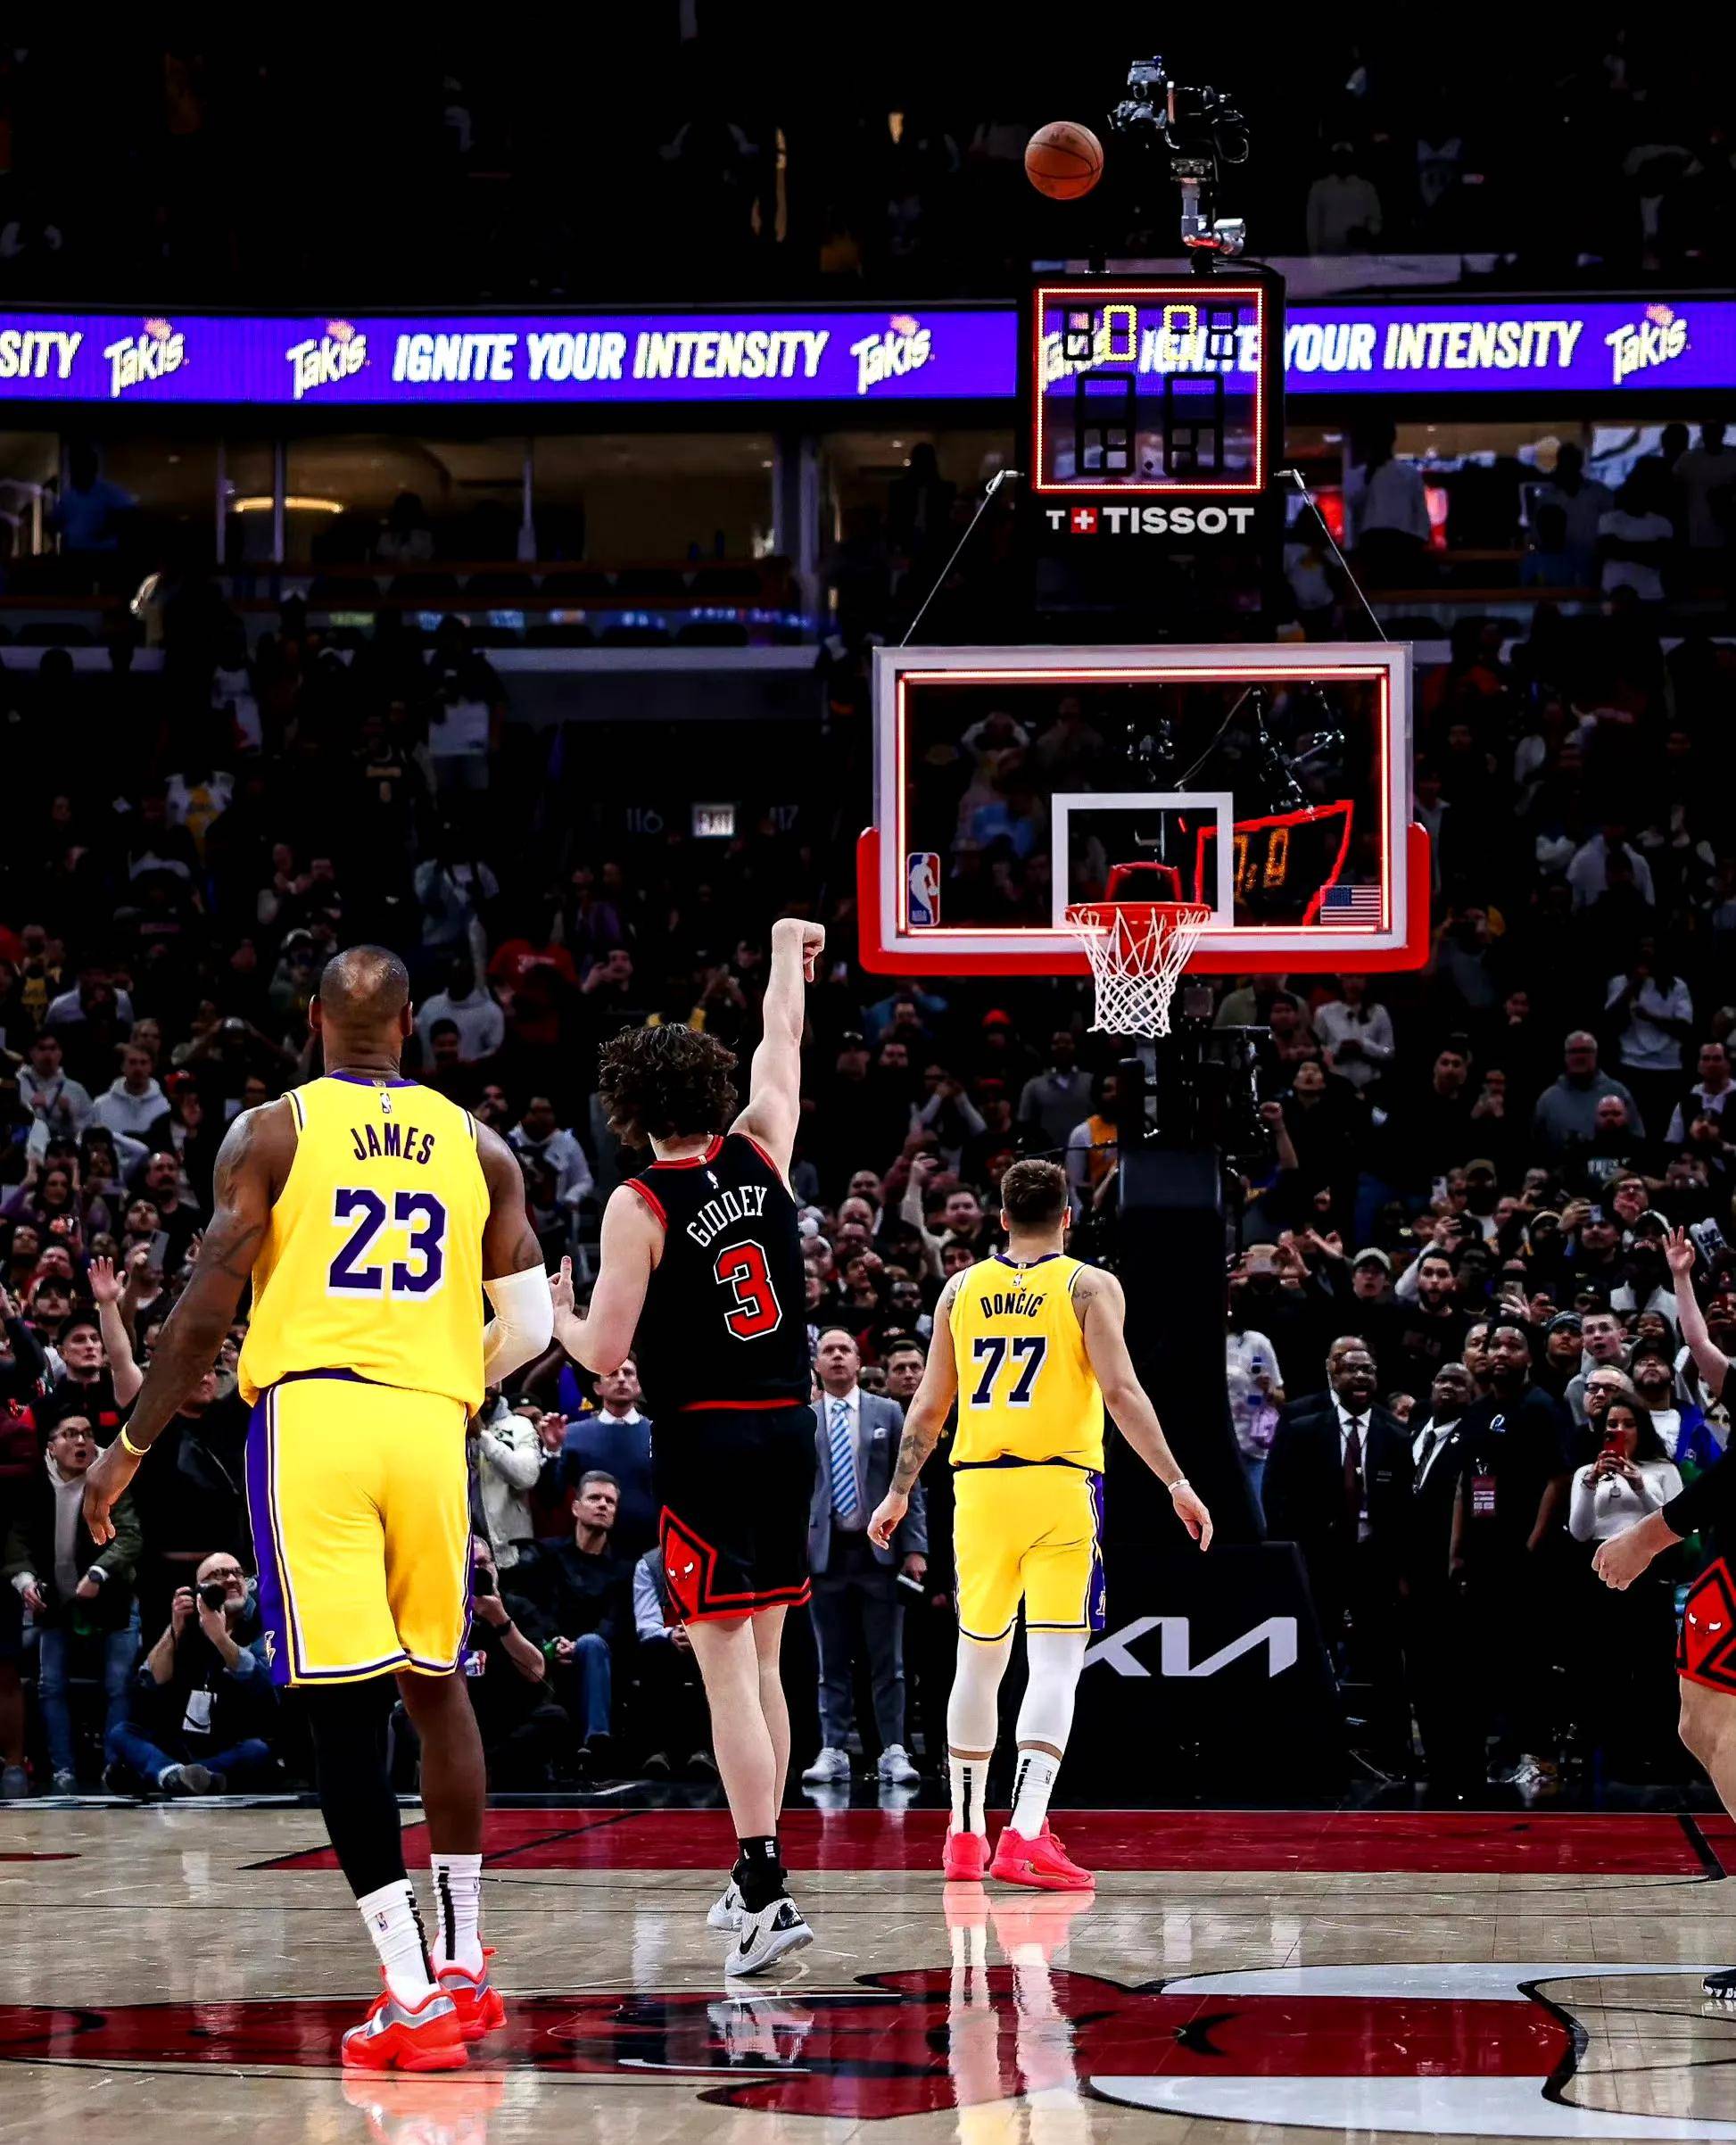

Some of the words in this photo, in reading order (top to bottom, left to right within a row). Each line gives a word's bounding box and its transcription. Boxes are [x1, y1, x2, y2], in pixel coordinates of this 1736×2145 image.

[392, 333, 518, 382] IGNITE
[526, 331, 626, 380] YOUR
[632, 330, 830, 379] INTENSITY
[1384, 320, 1583, 369] INTENSITY
[1103, 507, 1254, 534] TISSOT
[351, 1122, 435, 1164] JAMES
[686, 1186, 767, 1246] GIDDEY
[327, 1188, 447, 1299] 23
[714, 1239, 782, 1341] 3
[980, 1288, 1047, 1319] DONČIĆ
[971, 1336, 1046, 1408] 77
